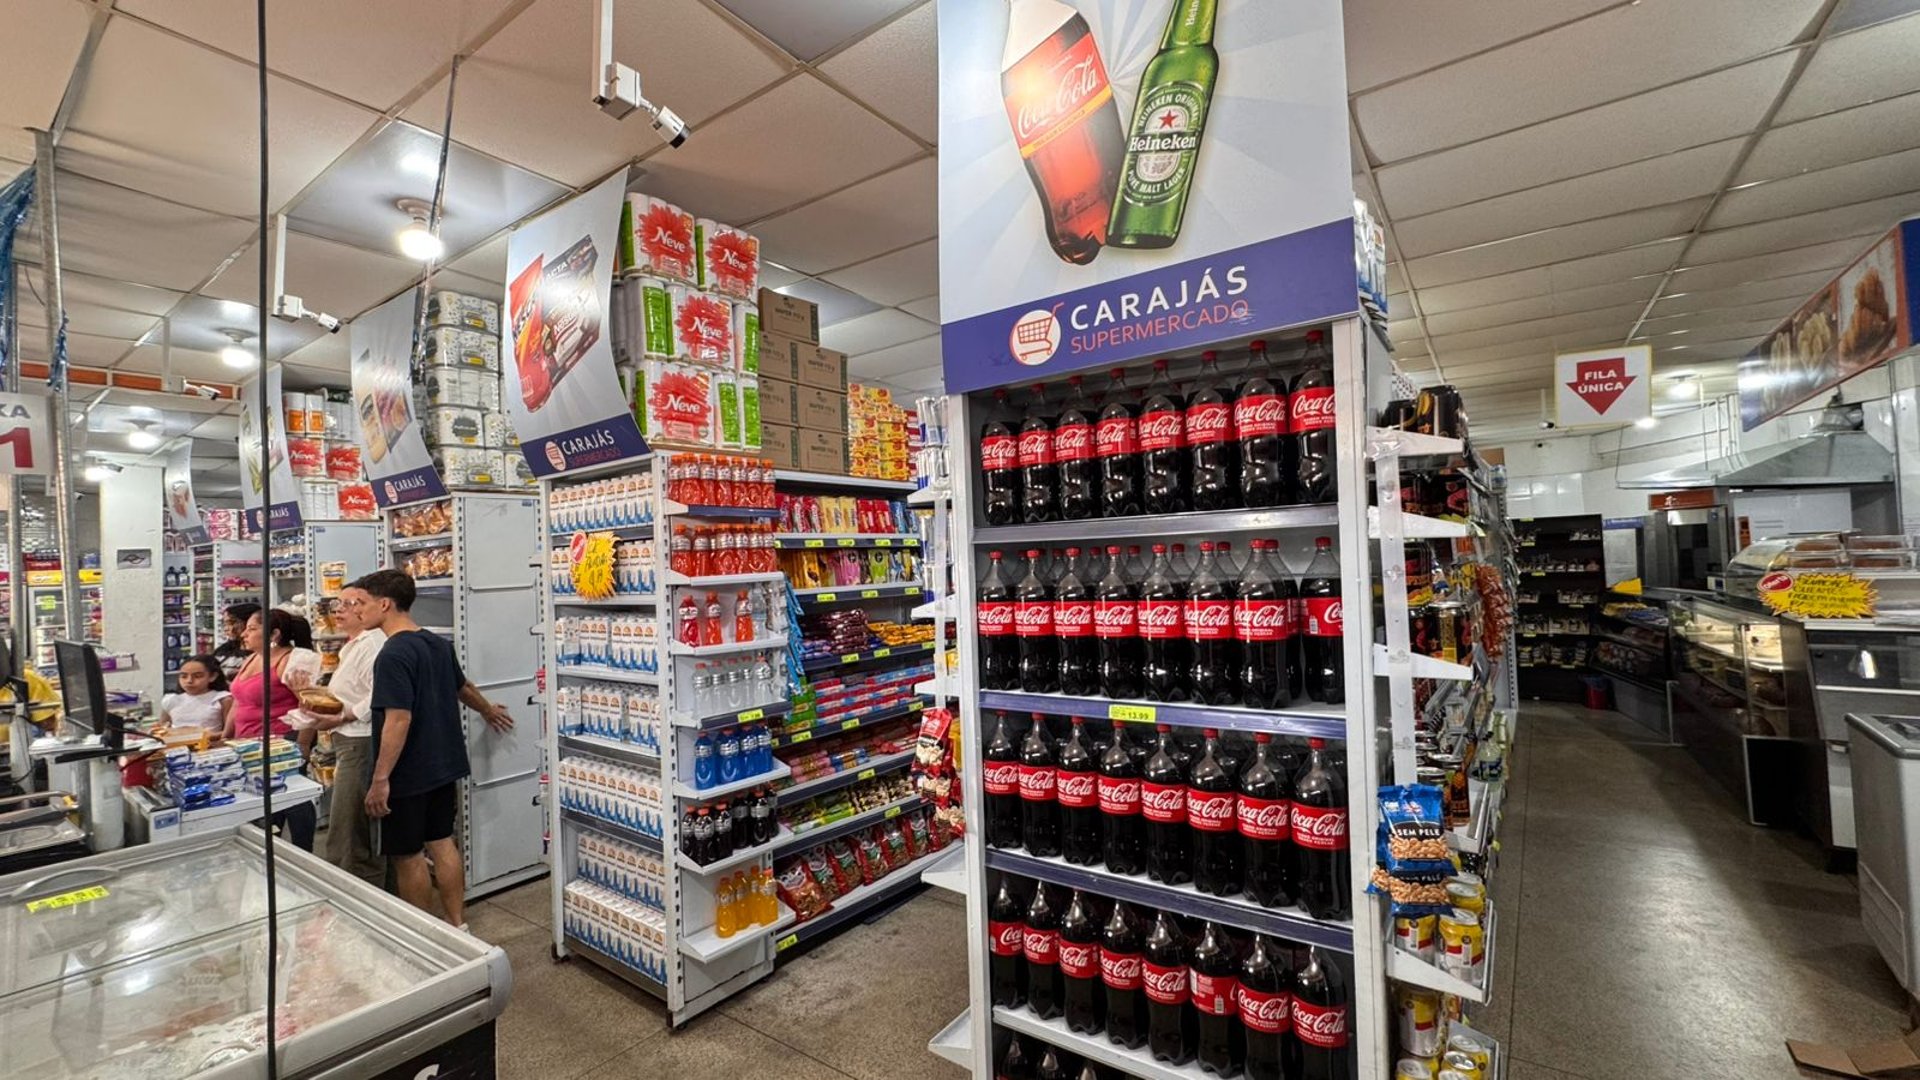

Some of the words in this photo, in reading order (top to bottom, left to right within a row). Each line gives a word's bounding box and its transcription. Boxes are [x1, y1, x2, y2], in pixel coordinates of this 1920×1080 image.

[1128, 134, 1197, 152] Heineken
[1140, 184, 1161, 194] MALT
[652, 227, 686, 252] Neve
[719, 249, 748, 271] Neve
[1071, 265, 1249, 331] CARAJÁS
[688, 317, 722, 339] Neve
[1071, 300, 1249, 355] SUPERMERCADO
[1584, 370, 1617, 381] FILA
[1578, 382, 1625, 394] ÚNICA
[664, 394, 700, 414] Neve
[0, 427, 34, 468] 1
[562, 429, 615, 455] CARAJÁS
[1397, 828, 1417, 836] SEM
[1418, 828, 1440, 836] PELE
